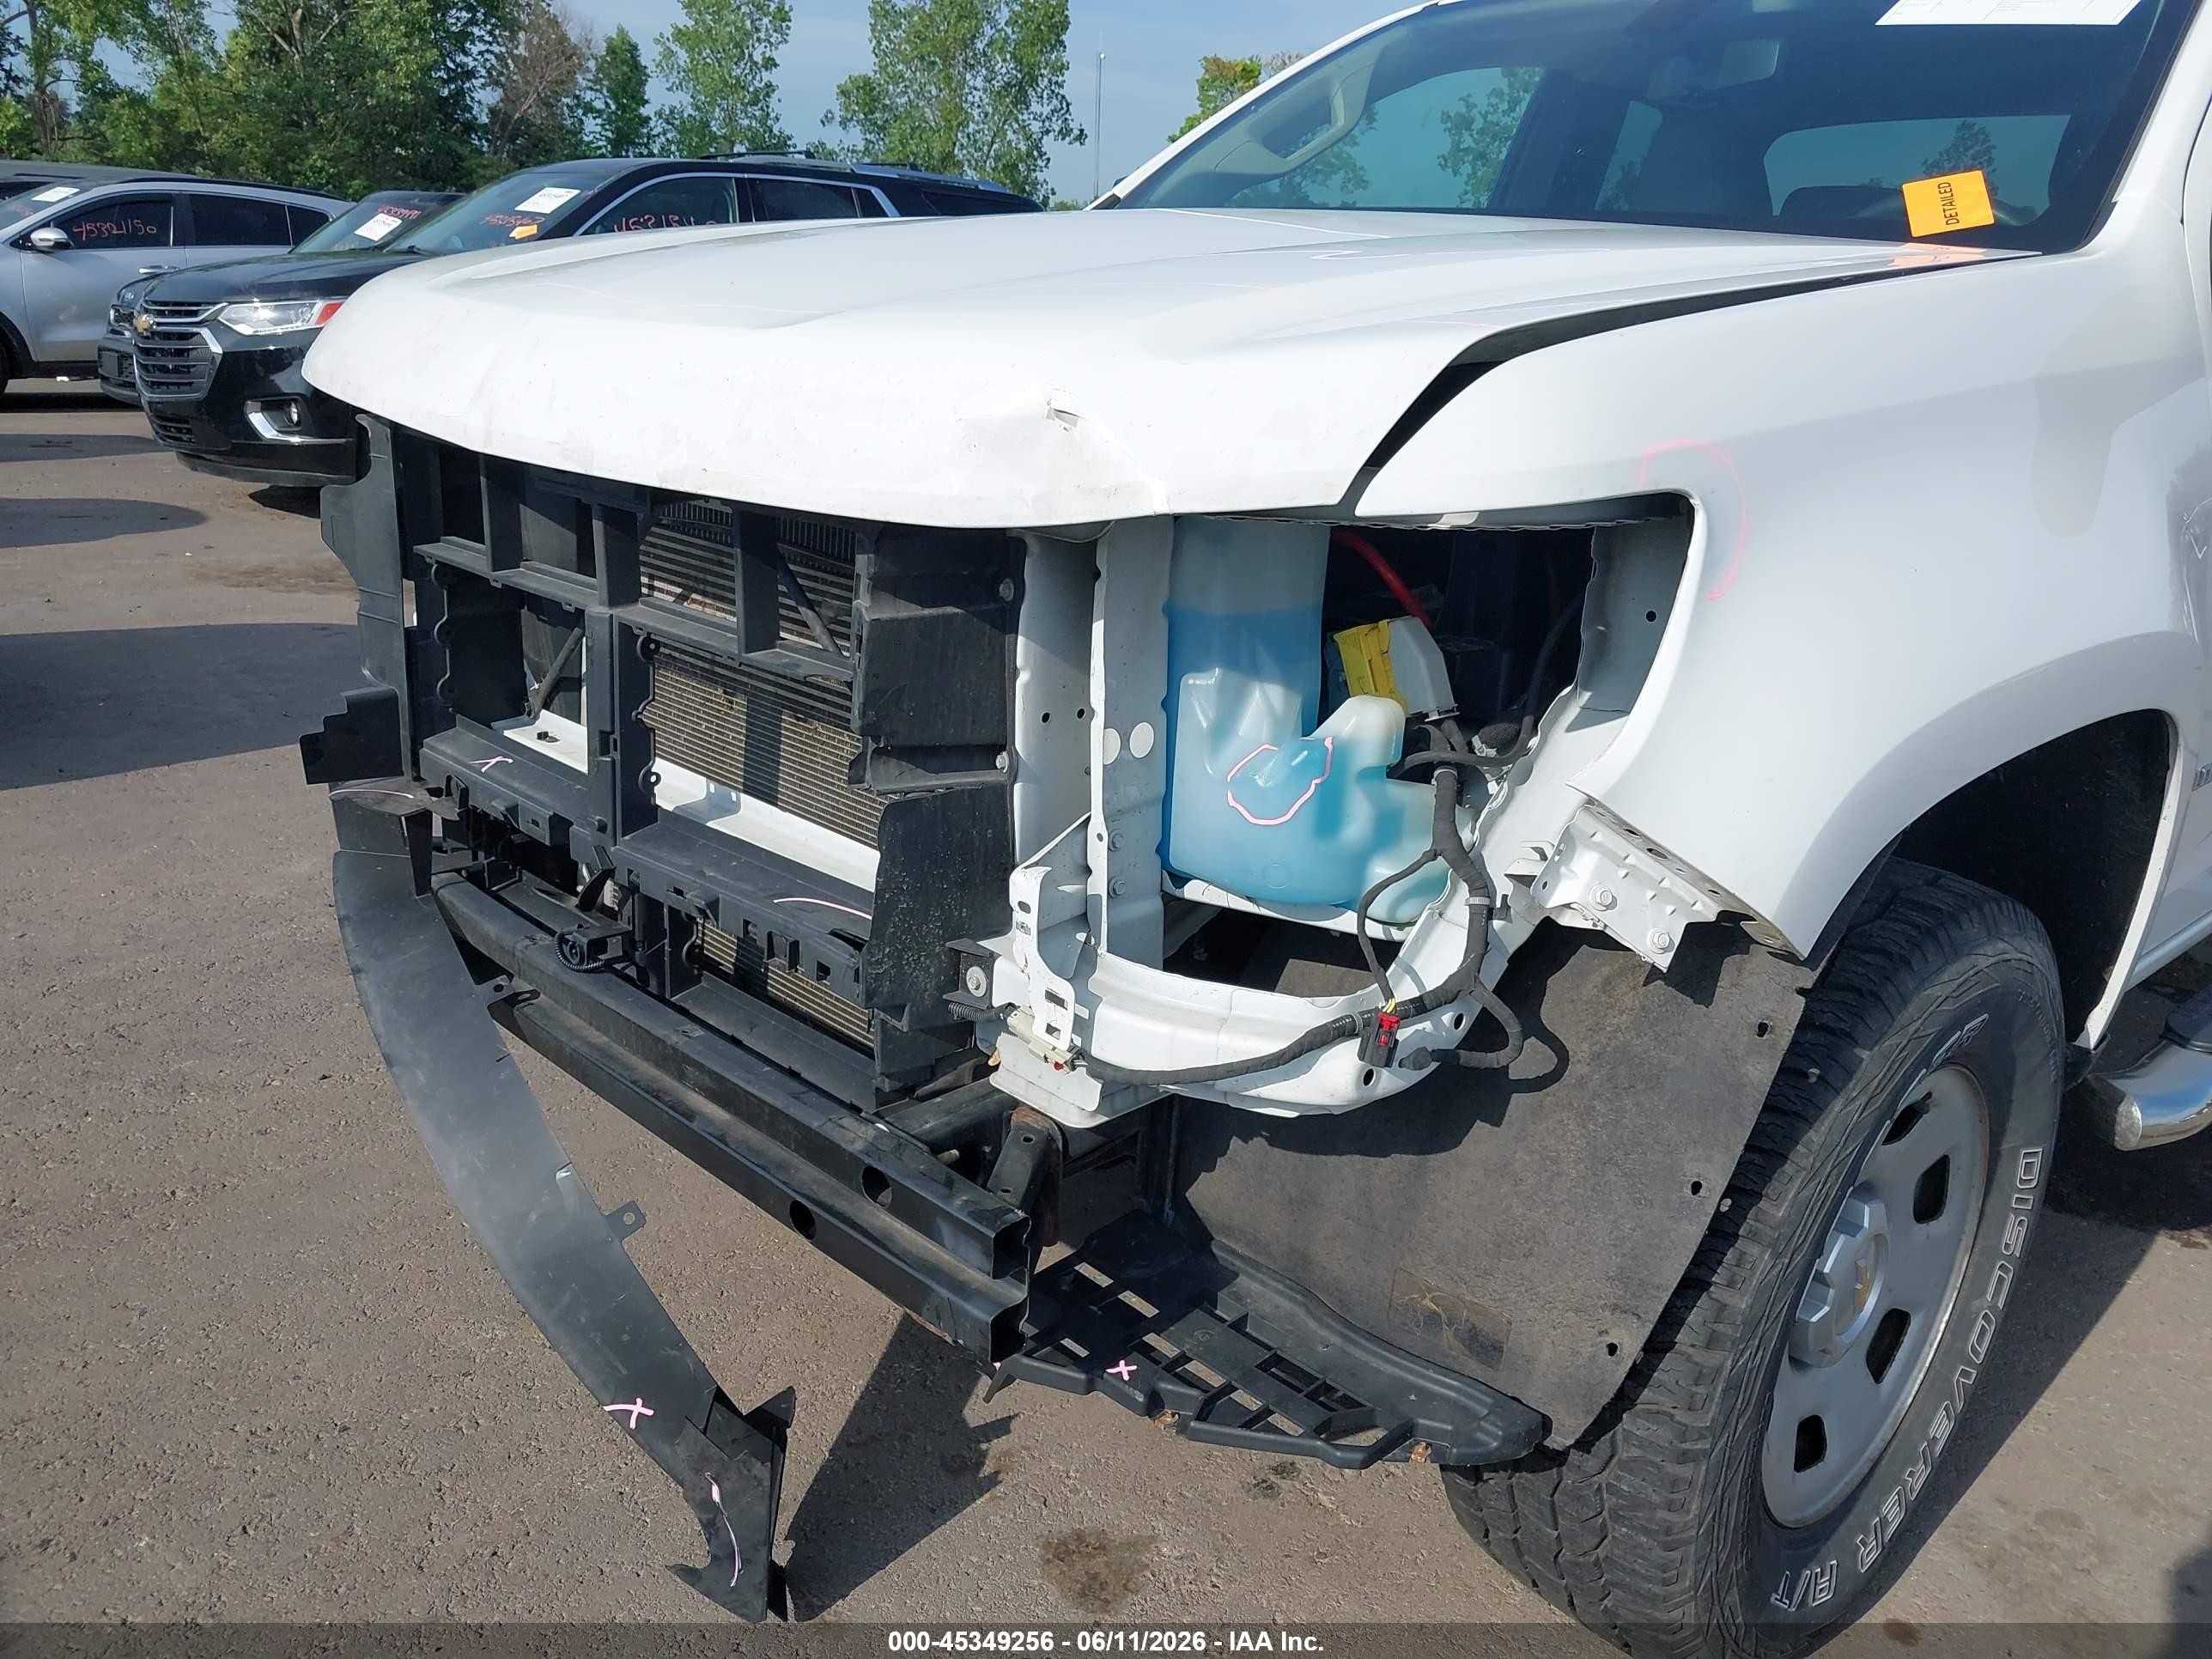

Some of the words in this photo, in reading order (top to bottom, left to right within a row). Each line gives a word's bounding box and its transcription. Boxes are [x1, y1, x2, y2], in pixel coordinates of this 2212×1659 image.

[1937, 181, 1960, 226] DETAILED
[72, 219, 157, 240] 45321150
[1856, 1148, 2043, 1573] DISCOVERER
[1770, 1559, 1838, 1612] A/T
